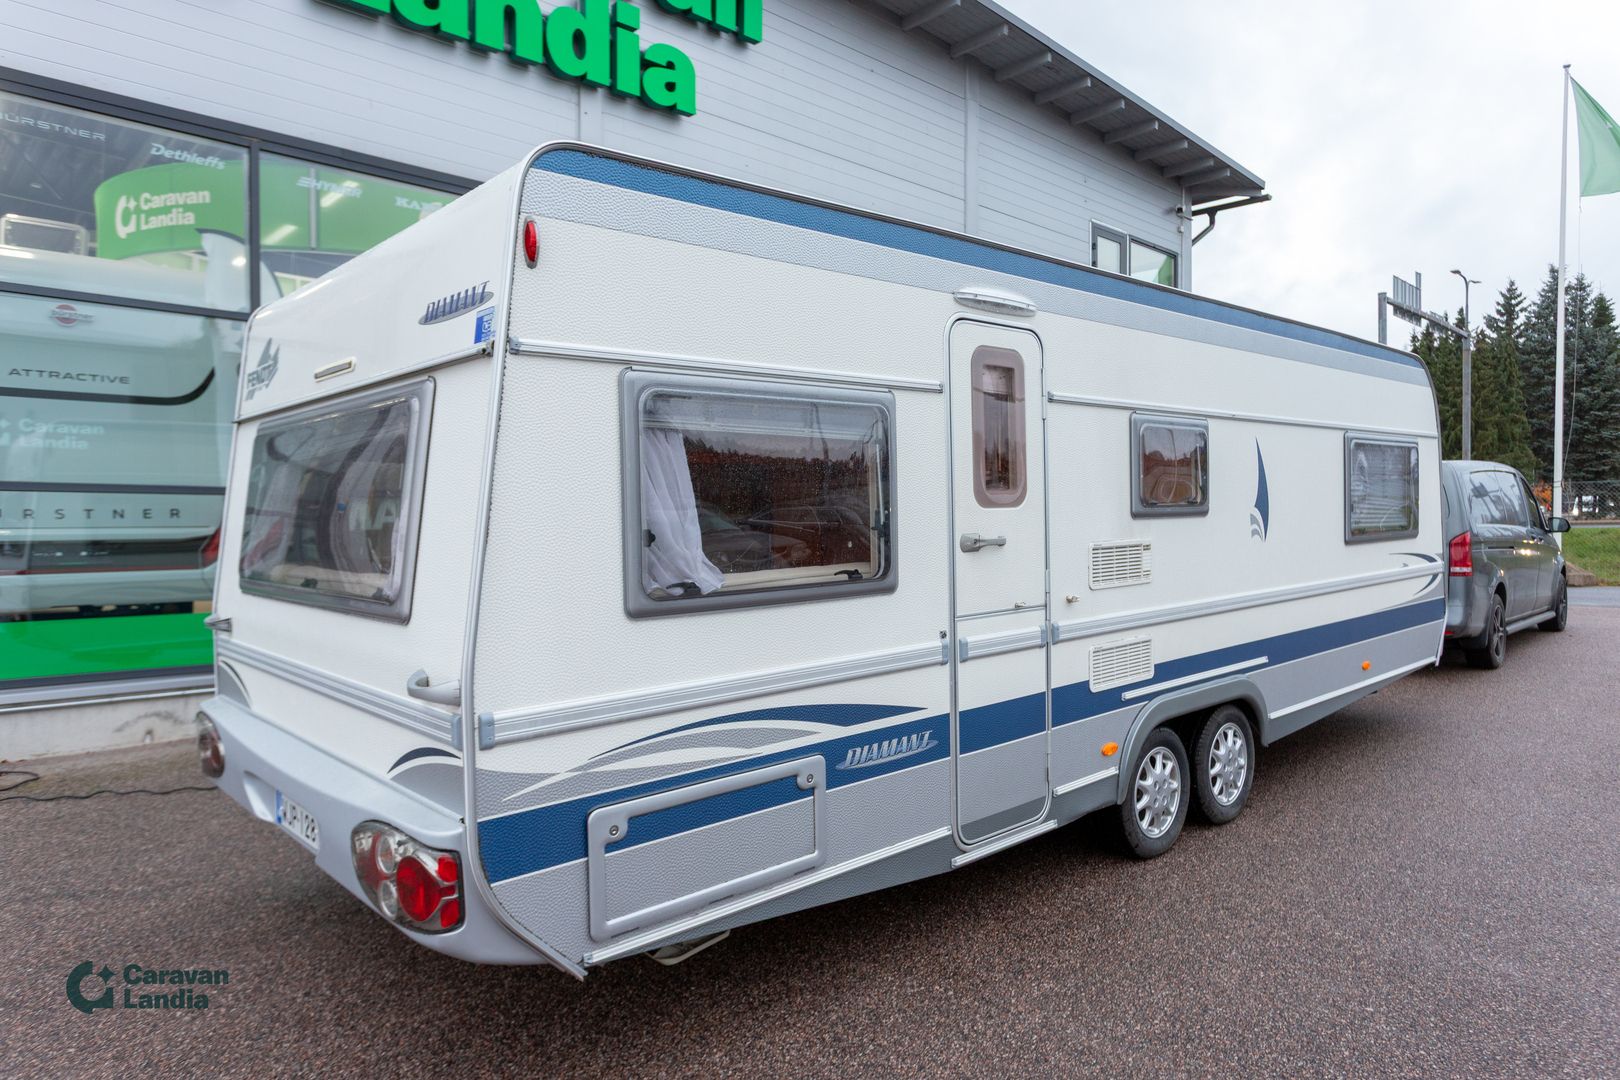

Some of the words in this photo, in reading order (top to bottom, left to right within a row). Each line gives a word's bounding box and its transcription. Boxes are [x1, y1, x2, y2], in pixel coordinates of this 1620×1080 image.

[318, 0, 697, 117] andia
[151, 142, 226, 170] Dethleffs
[139, 190, 211, 211] Caravan
[140, 207, 196, 231] Landia
[8, 368, 130, 385] ATTRACTIVE
[18, 418, 105, 436] Caravan
[19, 435, 89, 450] Landia
[0, 508, 181, 519] RSTNER
[844, 730, 933, 768] DIAMANT
